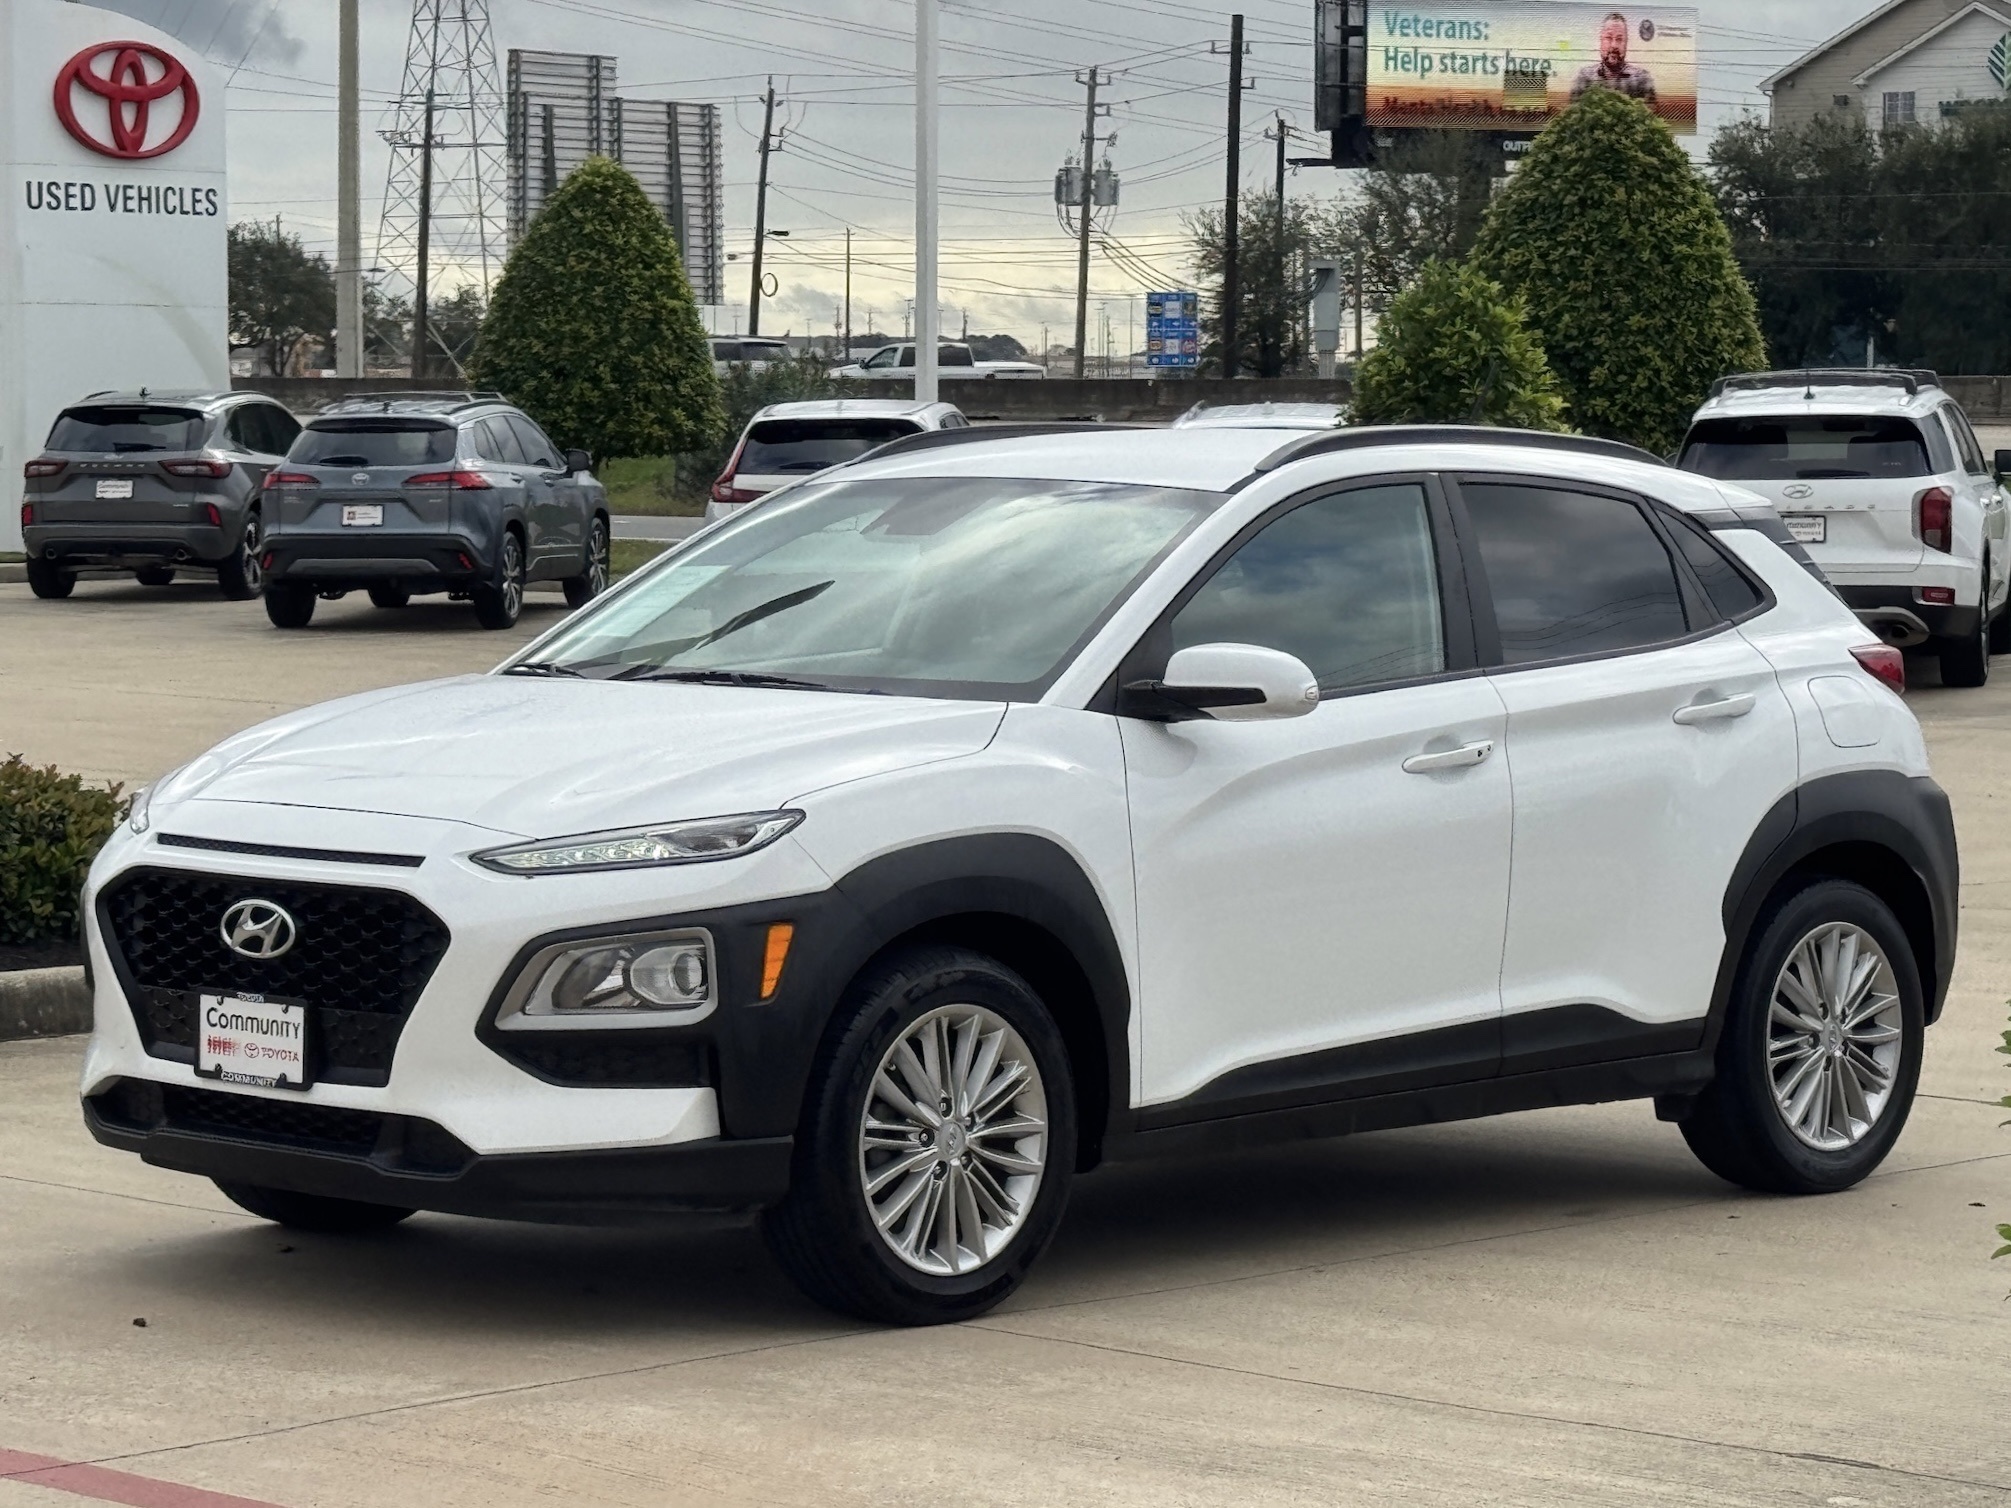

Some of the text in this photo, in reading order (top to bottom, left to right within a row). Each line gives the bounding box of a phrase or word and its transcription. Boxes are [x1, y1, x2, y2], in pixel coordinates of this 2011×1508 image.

[1384, 11, 1489, 40] Veterans:
[1384, 47, 1557, 79] Help starts here.
[26, 181, 218, 216] USED VEHICLES
[261, 1047, 299, 1062] TOYOTA
